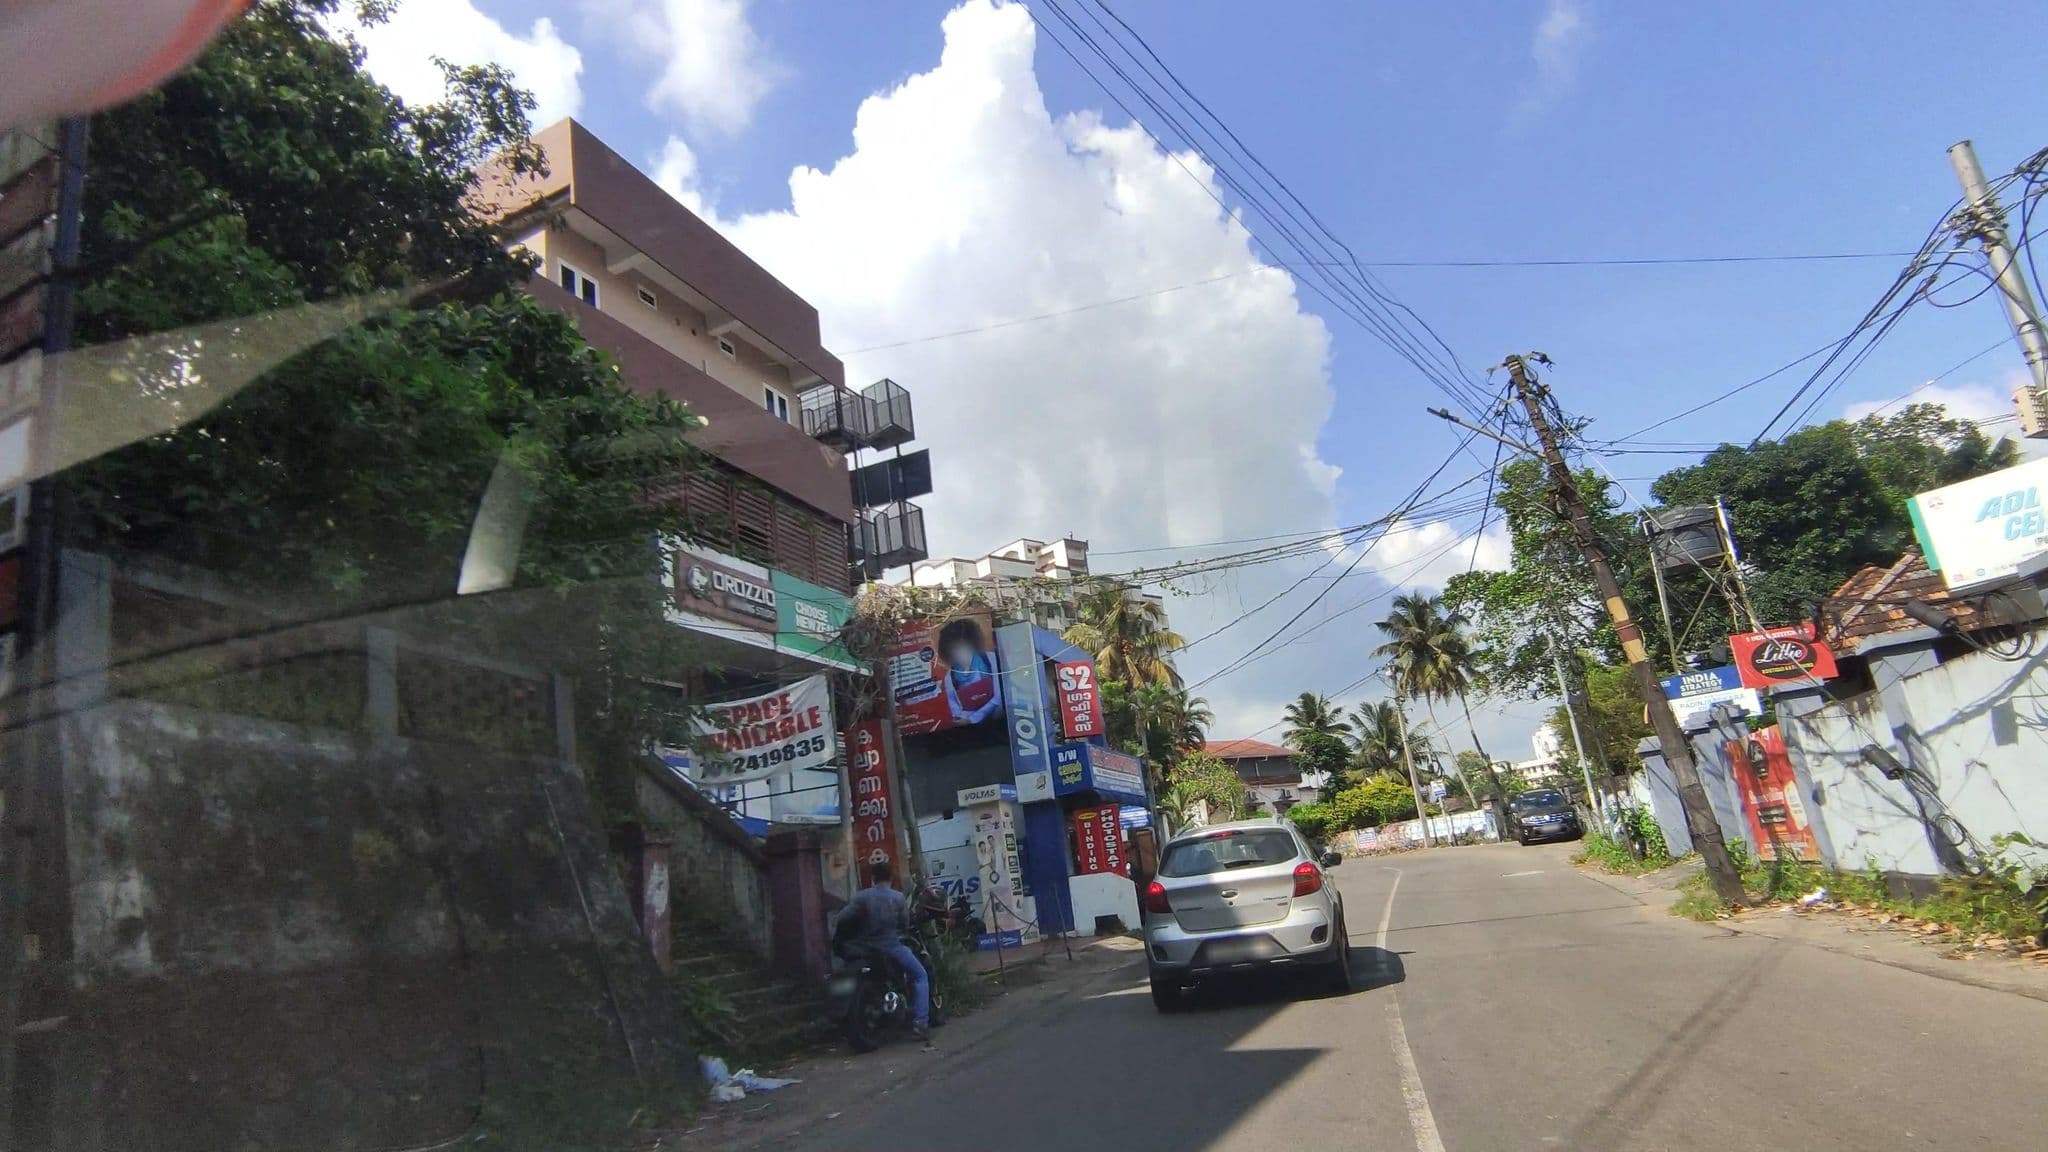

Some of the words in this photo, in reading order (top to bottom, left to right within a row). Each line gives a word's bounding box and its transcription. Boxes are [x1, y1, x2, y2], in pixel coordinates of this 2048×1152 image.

[712, 570, 777, 607] OROZZIO
[795, 601, 829, 622] CHOOSE
[1060, 665, 1092, 691] S2
[1680, 678, 1723, 692] STRATEGY
[1682, 671, 1719, 686] INDIA
[734, 734, 826, 774] 2419835
[1057, 749, 1077, 762] B/W
[964, 789, 996, 801] VOLTAS
[1083, 822, 1098, 870] BINDING
[1101, 808, 1120, 868] PHOTOSTAT
